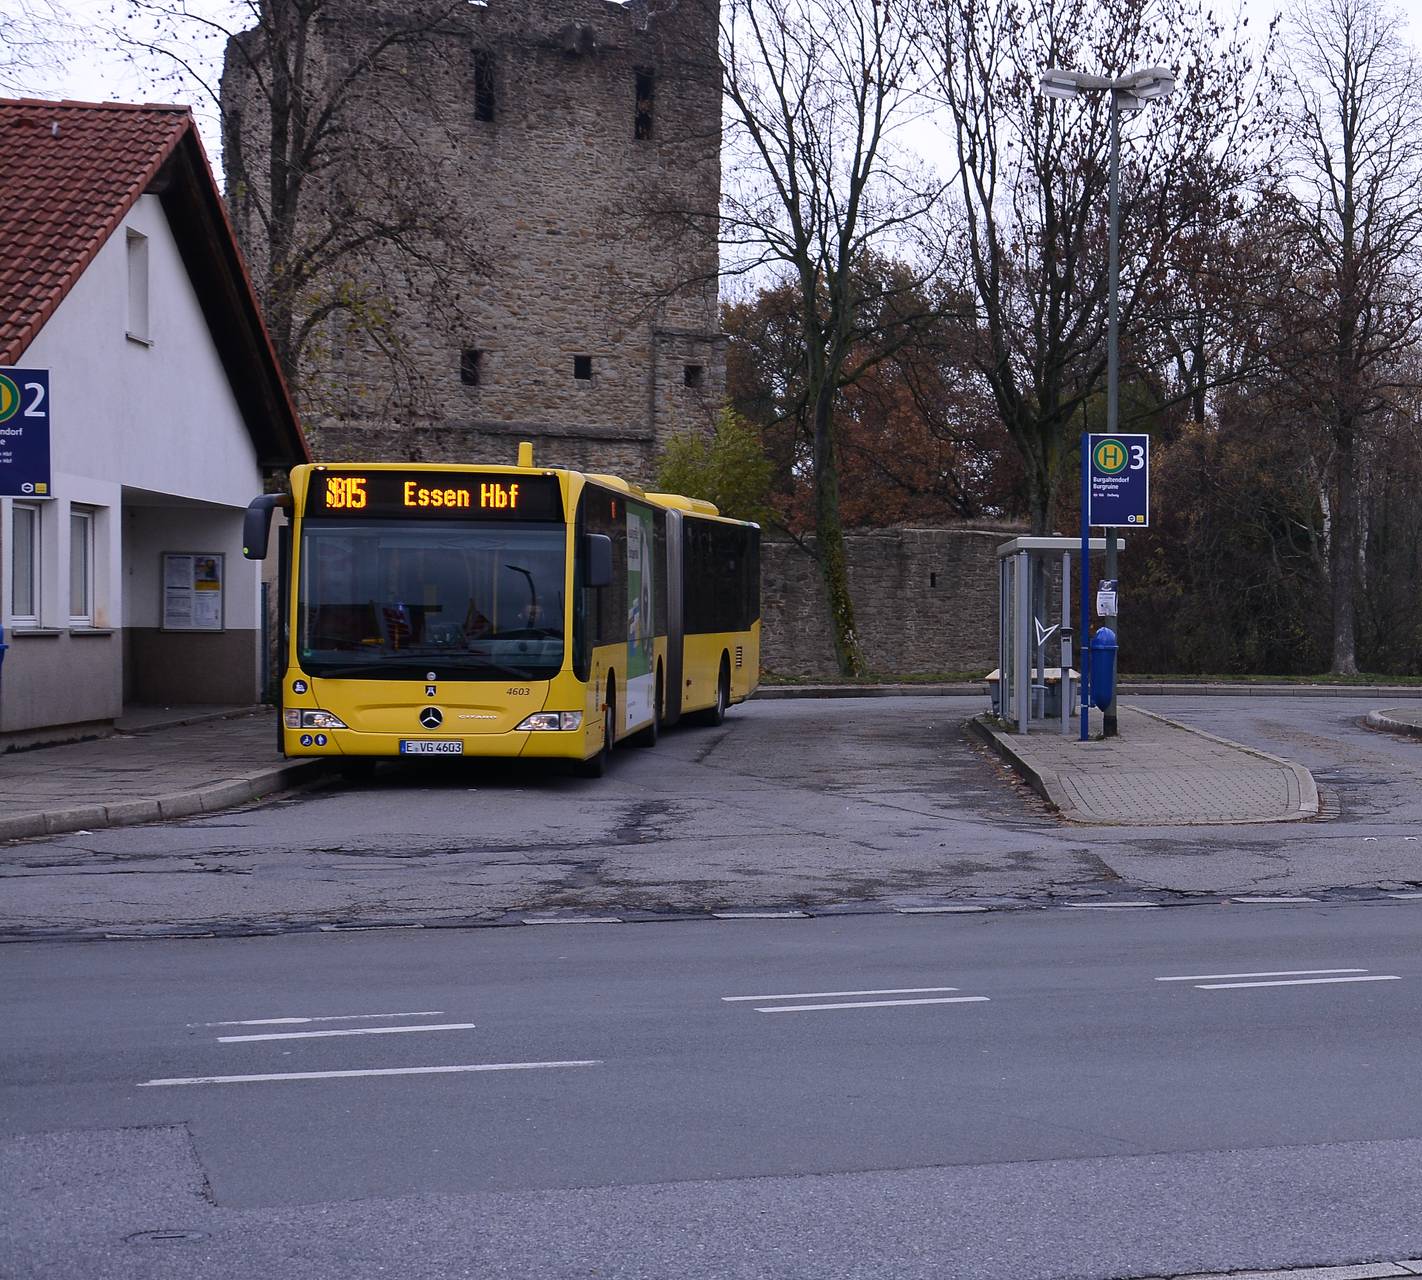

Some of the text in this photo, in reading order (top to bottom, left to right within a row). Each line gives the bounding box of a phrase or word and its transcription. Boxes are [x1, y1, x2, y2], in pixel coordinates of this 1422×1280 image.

[24, 382, 46, 417] 2
[1103, 445, 1145, 470] H 3
[404, 481, 470, 507] Essen
[480, 483, 519, 508] Hbf
[506, 687, 531, 696] 4603
[406, 742, 461, 753] E VG 4603
